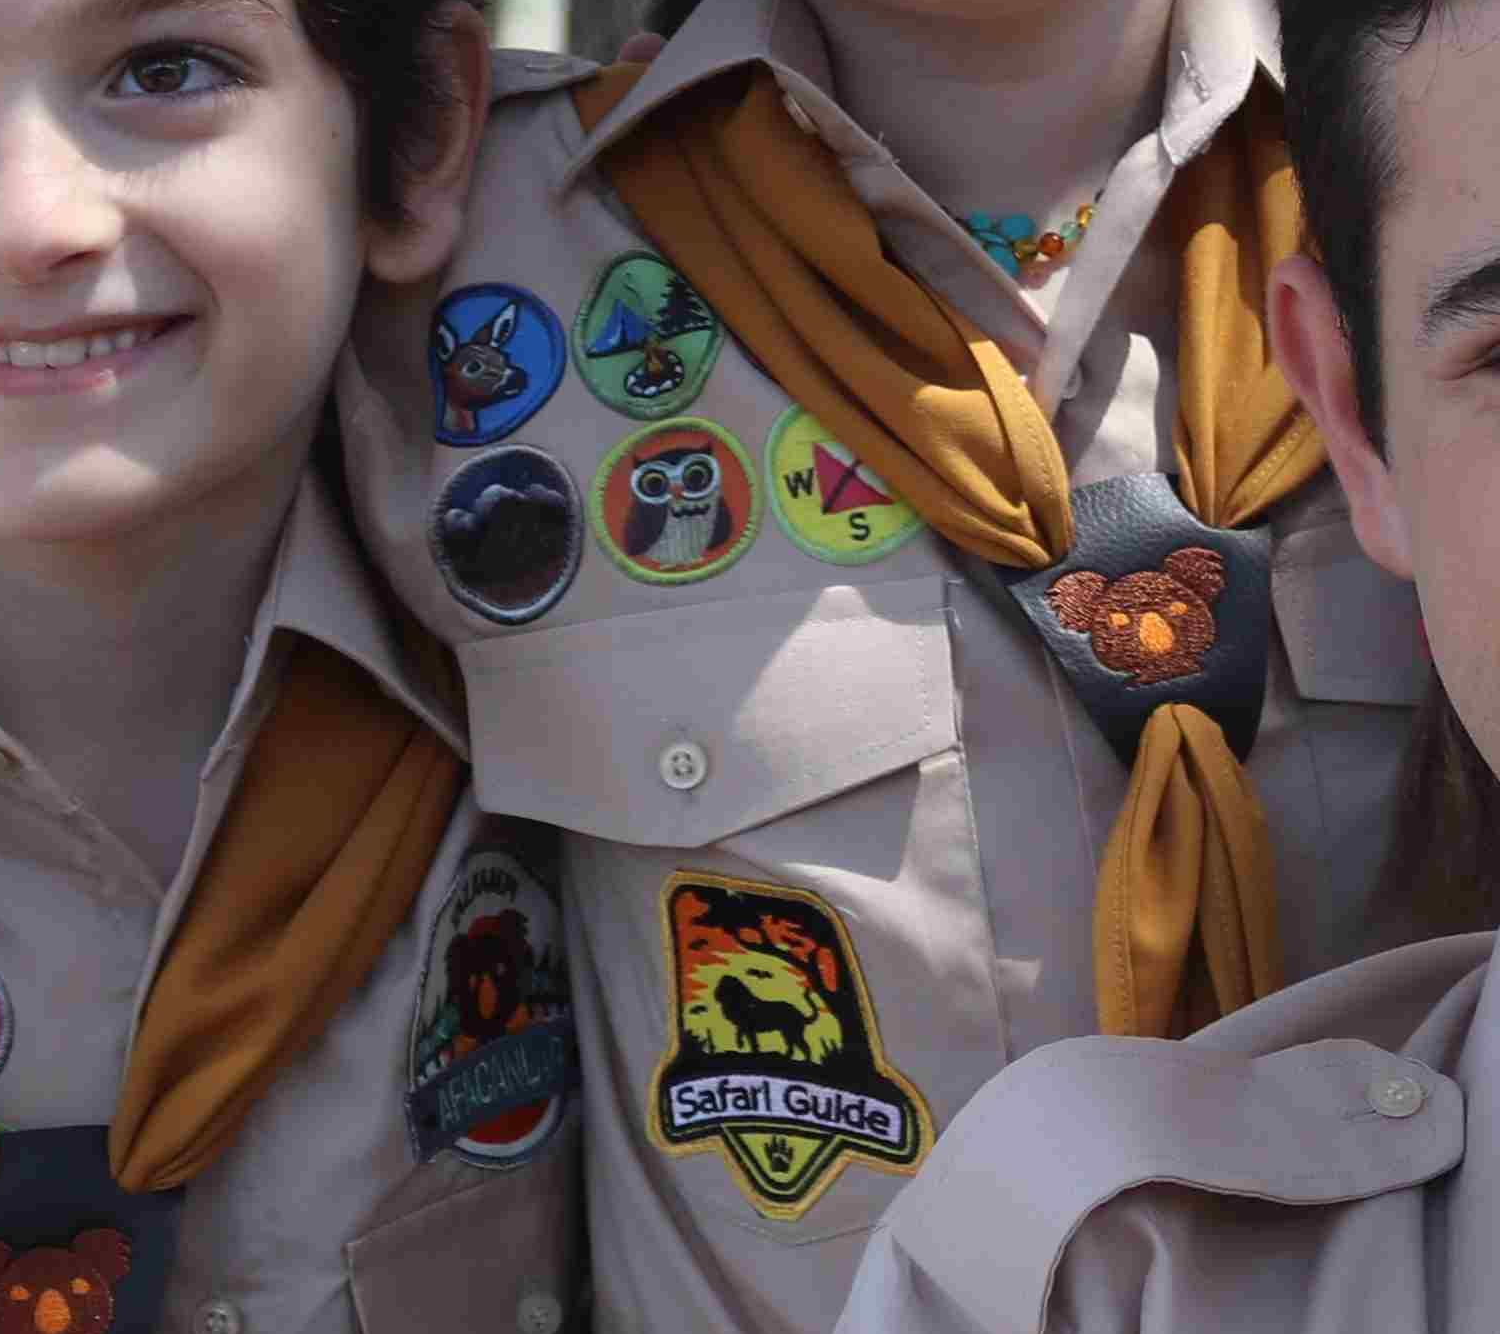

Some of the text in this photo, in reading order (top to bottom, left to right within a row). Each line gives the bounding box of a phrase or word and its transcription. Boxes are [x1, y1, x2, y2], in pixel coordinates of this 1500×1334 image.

[784, 468, 814, 499] W
[849, 512, 871, 541] S
[676, 1079, 890, 1136] Safari Guide
